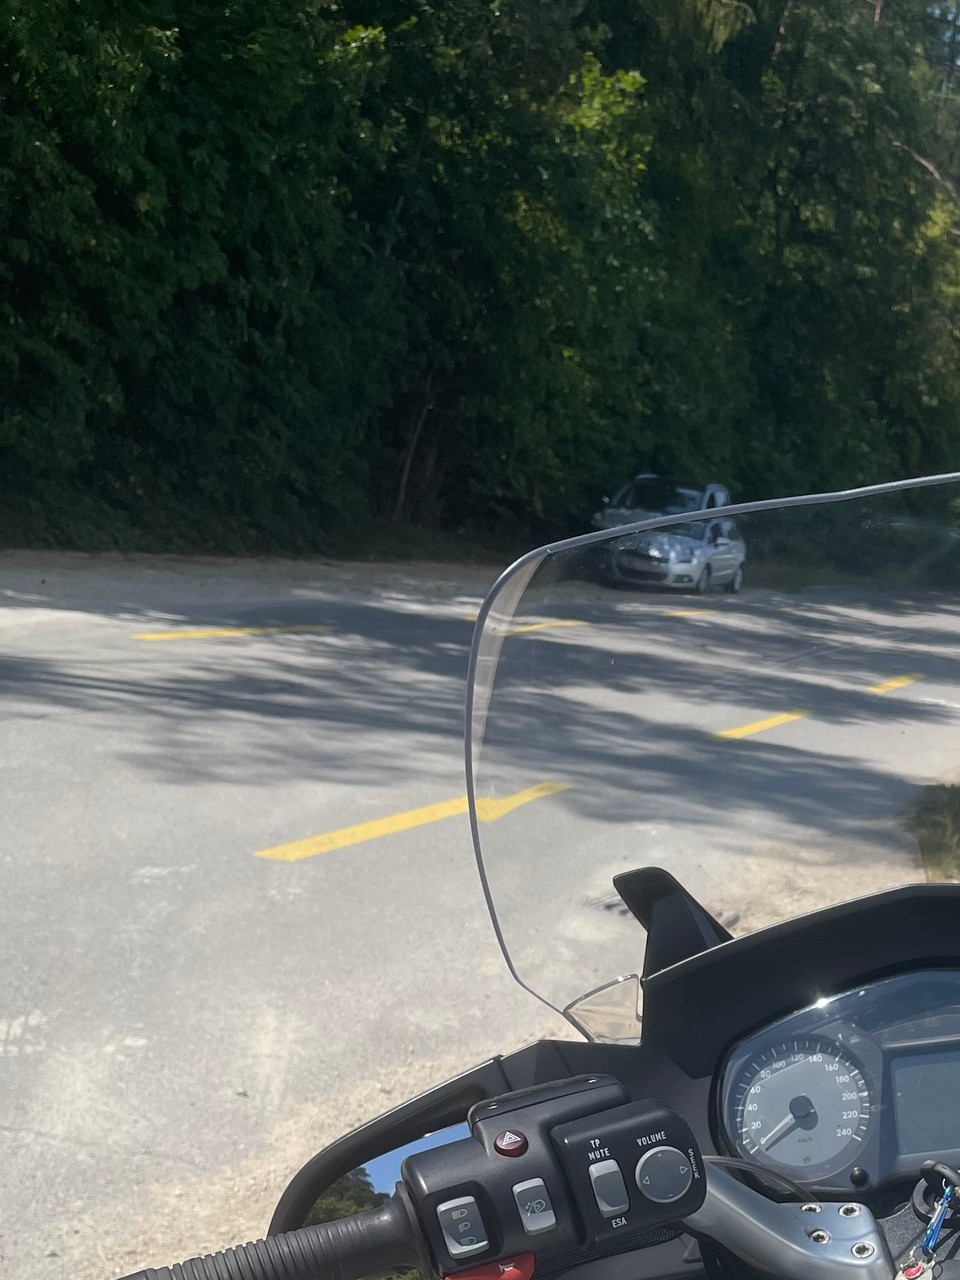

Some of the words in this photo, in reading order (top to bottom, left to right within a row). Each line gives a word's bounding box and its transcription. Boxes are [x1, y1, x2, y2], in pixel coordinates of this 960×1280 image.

[790, 1053, 804, 1061] 120
[808, 1055, 823, 1063] 140
[772, 1060, 786, 1069] 100
[824, 1063, 839, 1071] 160
[760, 1070, 771, 1078] 80
[835, 1075, 850, 1083] 180
[750, 1086, 761, 1094] 60
[841, 1092, 857, 1101] 200
[842, 1110, 858, 1119] 220
[751, 1121, 762, 1129] 20
[836, 1128, 852, 1137] 240
[636, 1131, 667, 1147] VOLUME
[590, 1139, 600, 1149] TP
[588, 1147, 611, 1160] MUTE
[687, 1148, 700, 1179] SEEK
[611, 1217, 628, 1228] ESA
